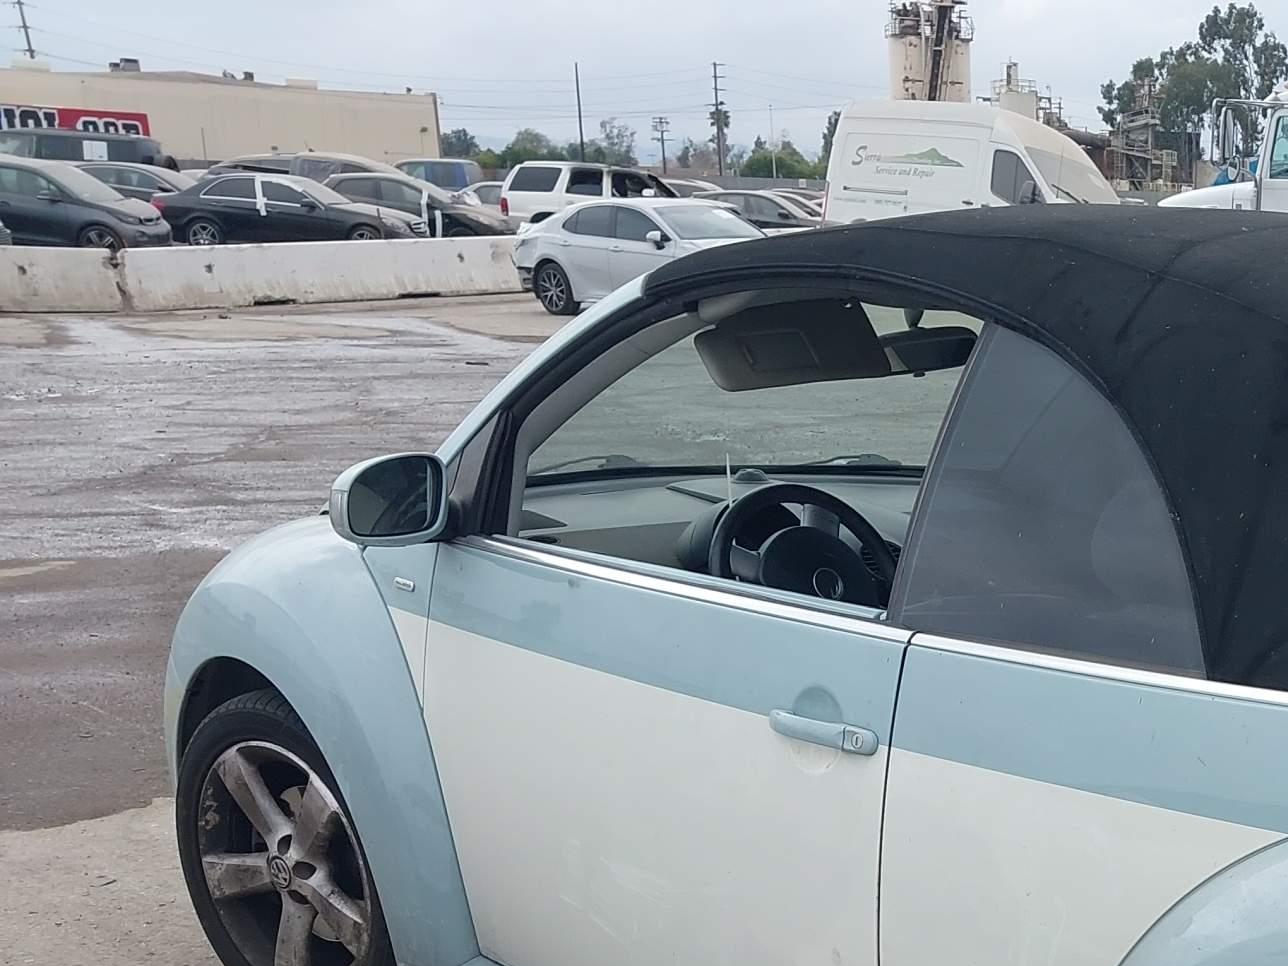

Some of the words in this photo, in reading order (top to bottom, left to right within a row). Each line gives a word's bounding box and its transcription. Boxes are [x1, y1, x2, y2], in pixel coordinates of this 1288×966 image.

[851, 145, 881, 166] Sierra
[874, 166, 898, 177] Service
[899, 167, 911, 177] and
[911, 167, 936, 179] Repair
